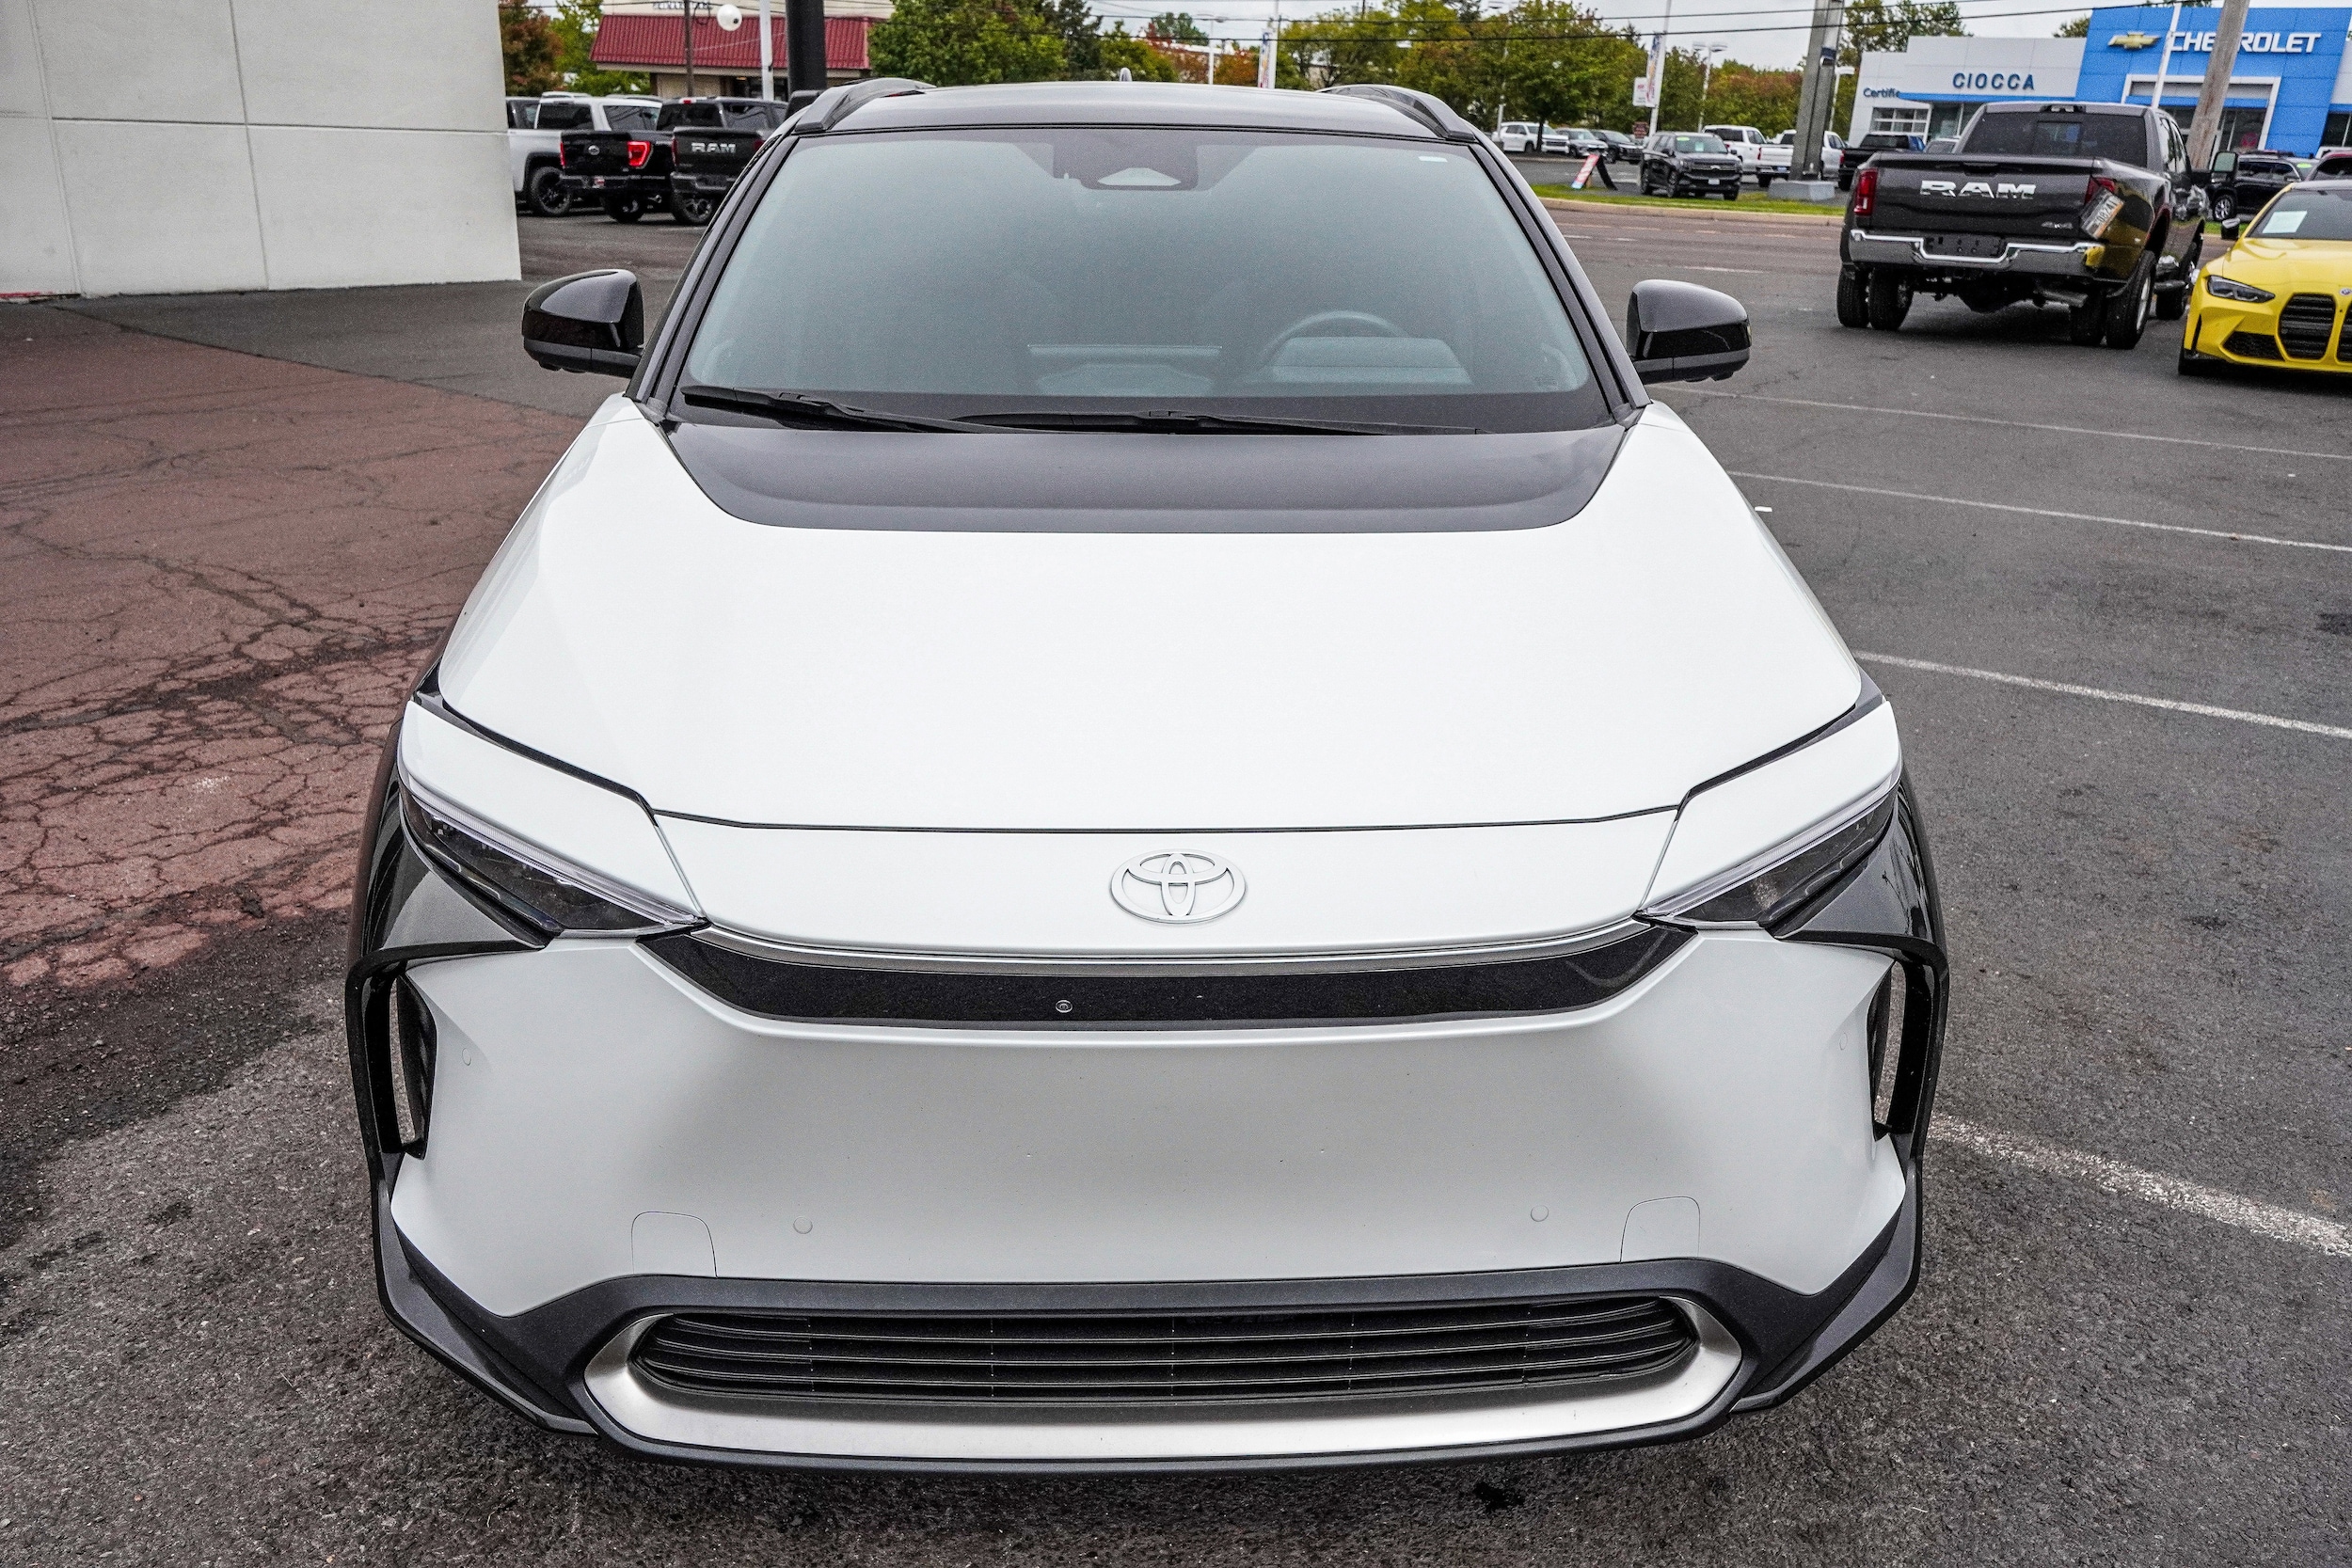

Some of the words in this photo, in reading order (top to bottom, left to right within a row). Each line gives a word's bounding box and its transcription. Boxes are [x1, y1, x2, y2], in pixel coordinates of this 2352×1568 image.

[2169, 31, 2321, 54] CHEROLET
[1952, 72, 2034, 91] CIOCCA
[691, 142, 736, 153] RAM
[1920, 180, 2036, 199] RAM
